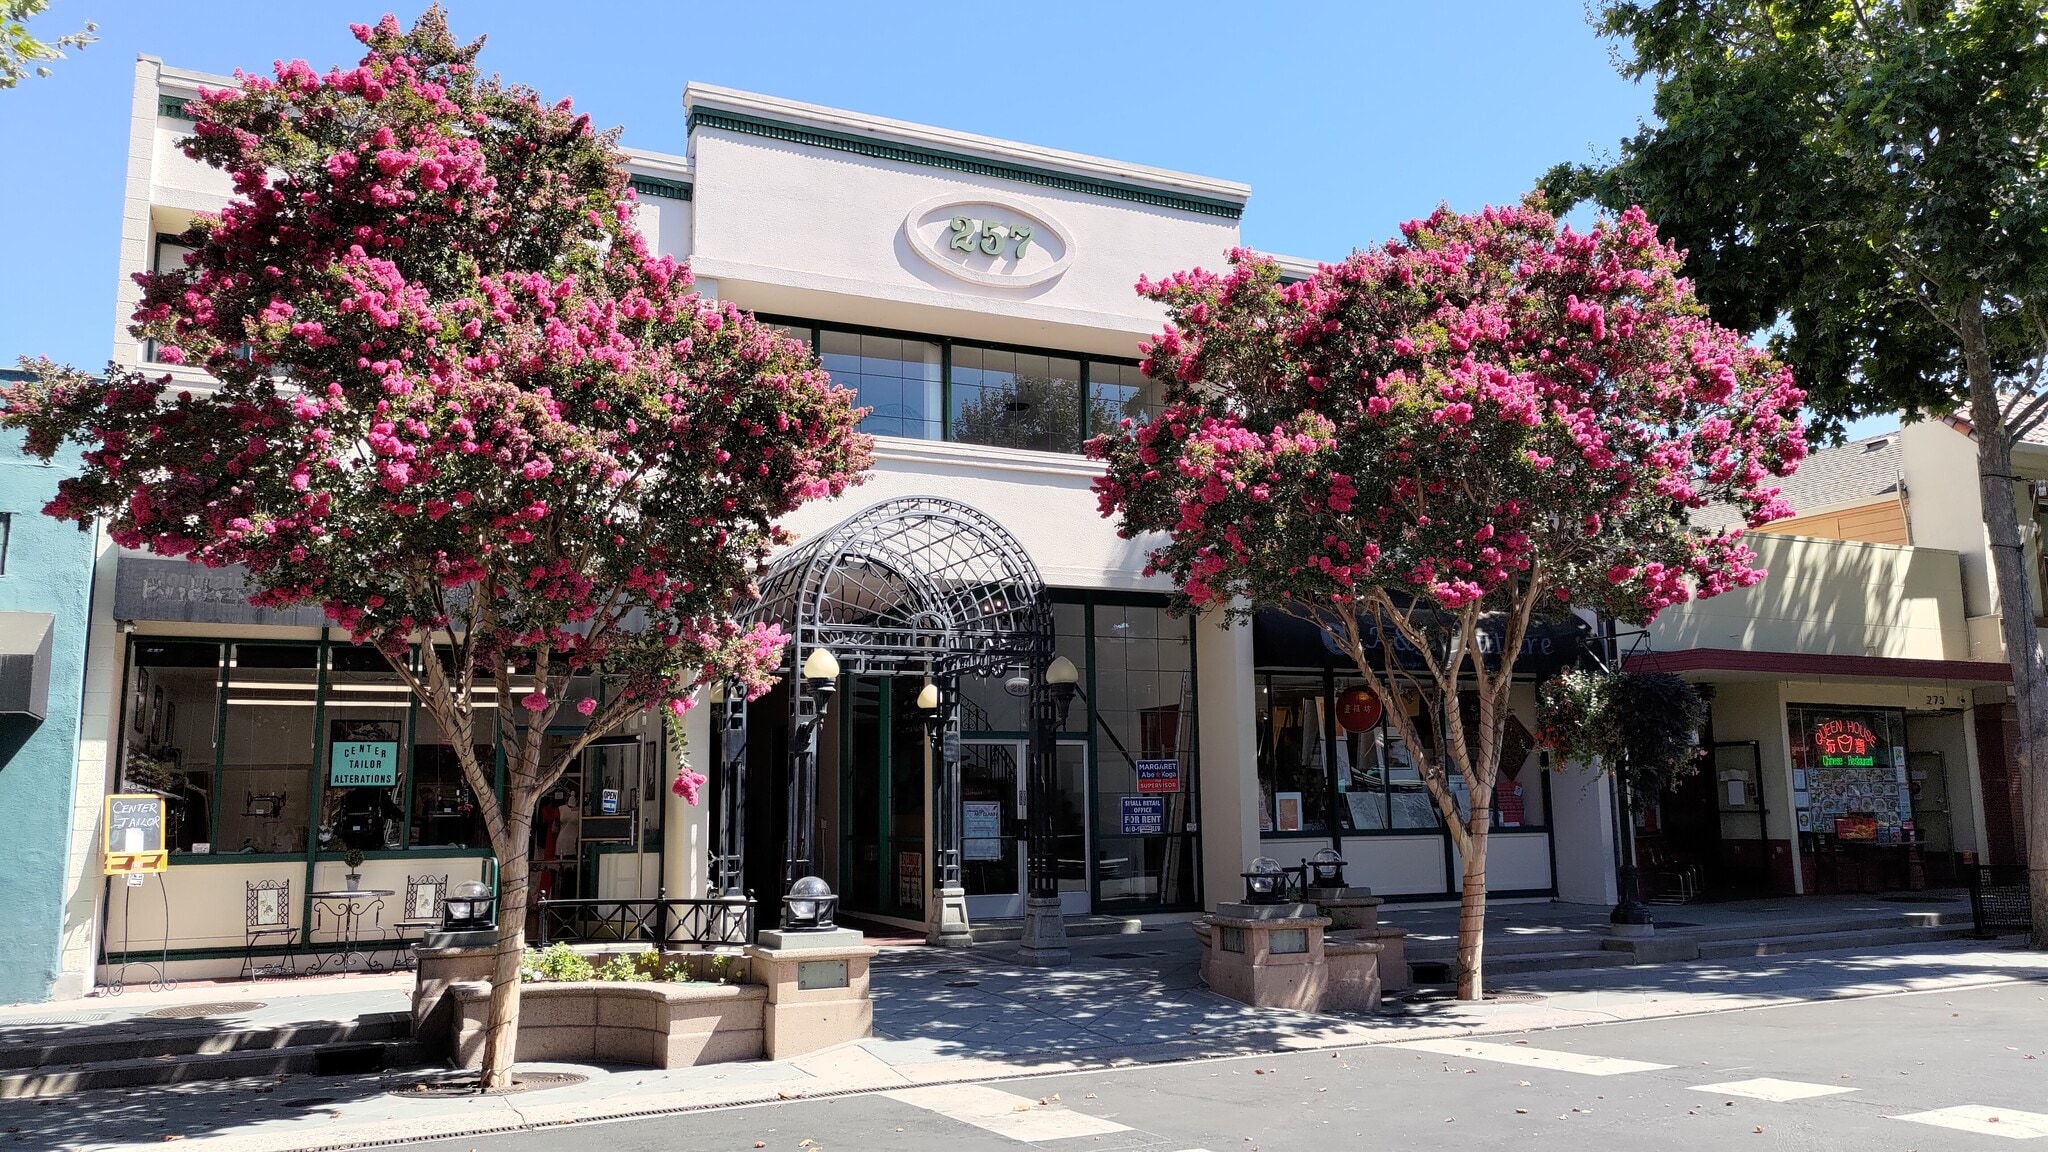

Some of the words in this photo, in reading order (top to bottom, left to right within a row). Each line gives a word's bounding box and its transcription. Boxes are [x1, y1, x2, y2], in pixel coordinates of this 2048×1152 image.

[950, 216, 1034, 259] 257
[1926, 695, 1945, 705] 273
[1815, 720, 1843, 745] QUEEN
[1846, 720, 1876, 748] HOUSE
[344, 744, 387, 758] CENTER
[349, 760, 382, 769] TAILOR
[1822, 755, 1844, 767] Chinese
[334, 775, 392, 784] ALTERATIONS
[604, 791, 617, 800] OPEN
[112, 801, 158, 815] CENTER
[114, 816, 160, 829] TAILOR
[1124, 815, 1140, 824] FOR
[1141, 815, 1162, 824] RENT
